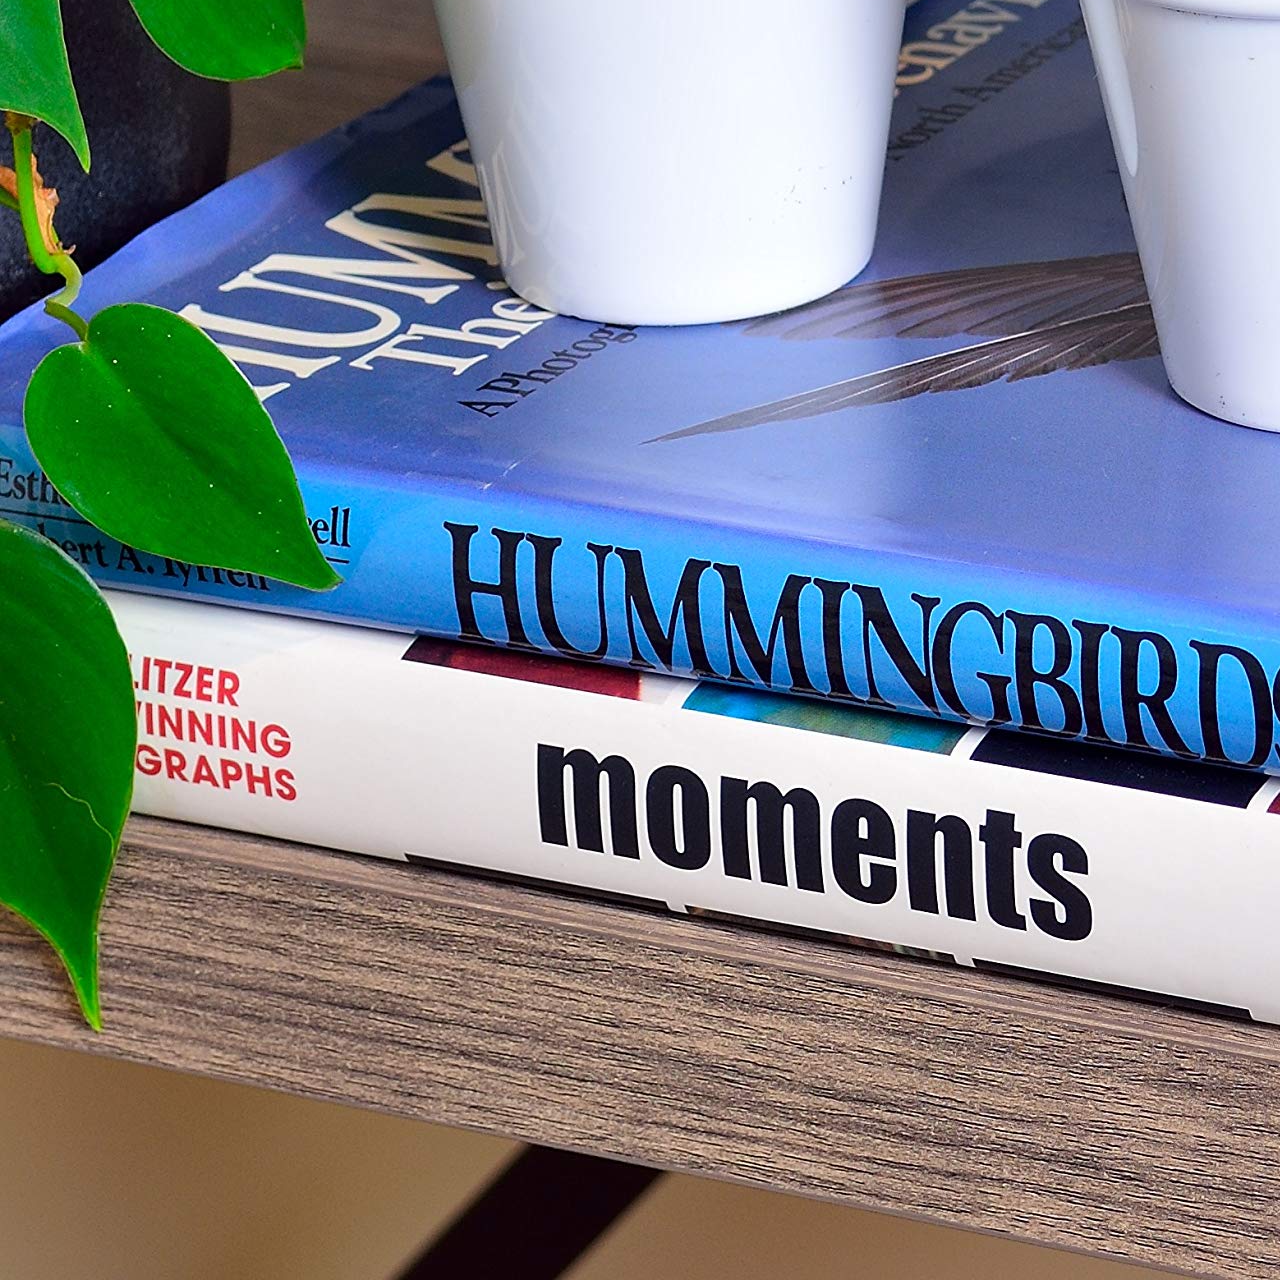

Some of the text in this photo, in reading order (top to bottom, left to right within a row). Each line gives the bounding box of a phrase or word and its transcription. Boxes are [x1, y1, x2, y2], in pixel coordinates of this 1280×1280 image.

[457, 400, 518, 418] A
[0, 458, 71, 508] Esth
[136, 701, 292, 759] INNING
[537, 742, 1093, 942] moments
